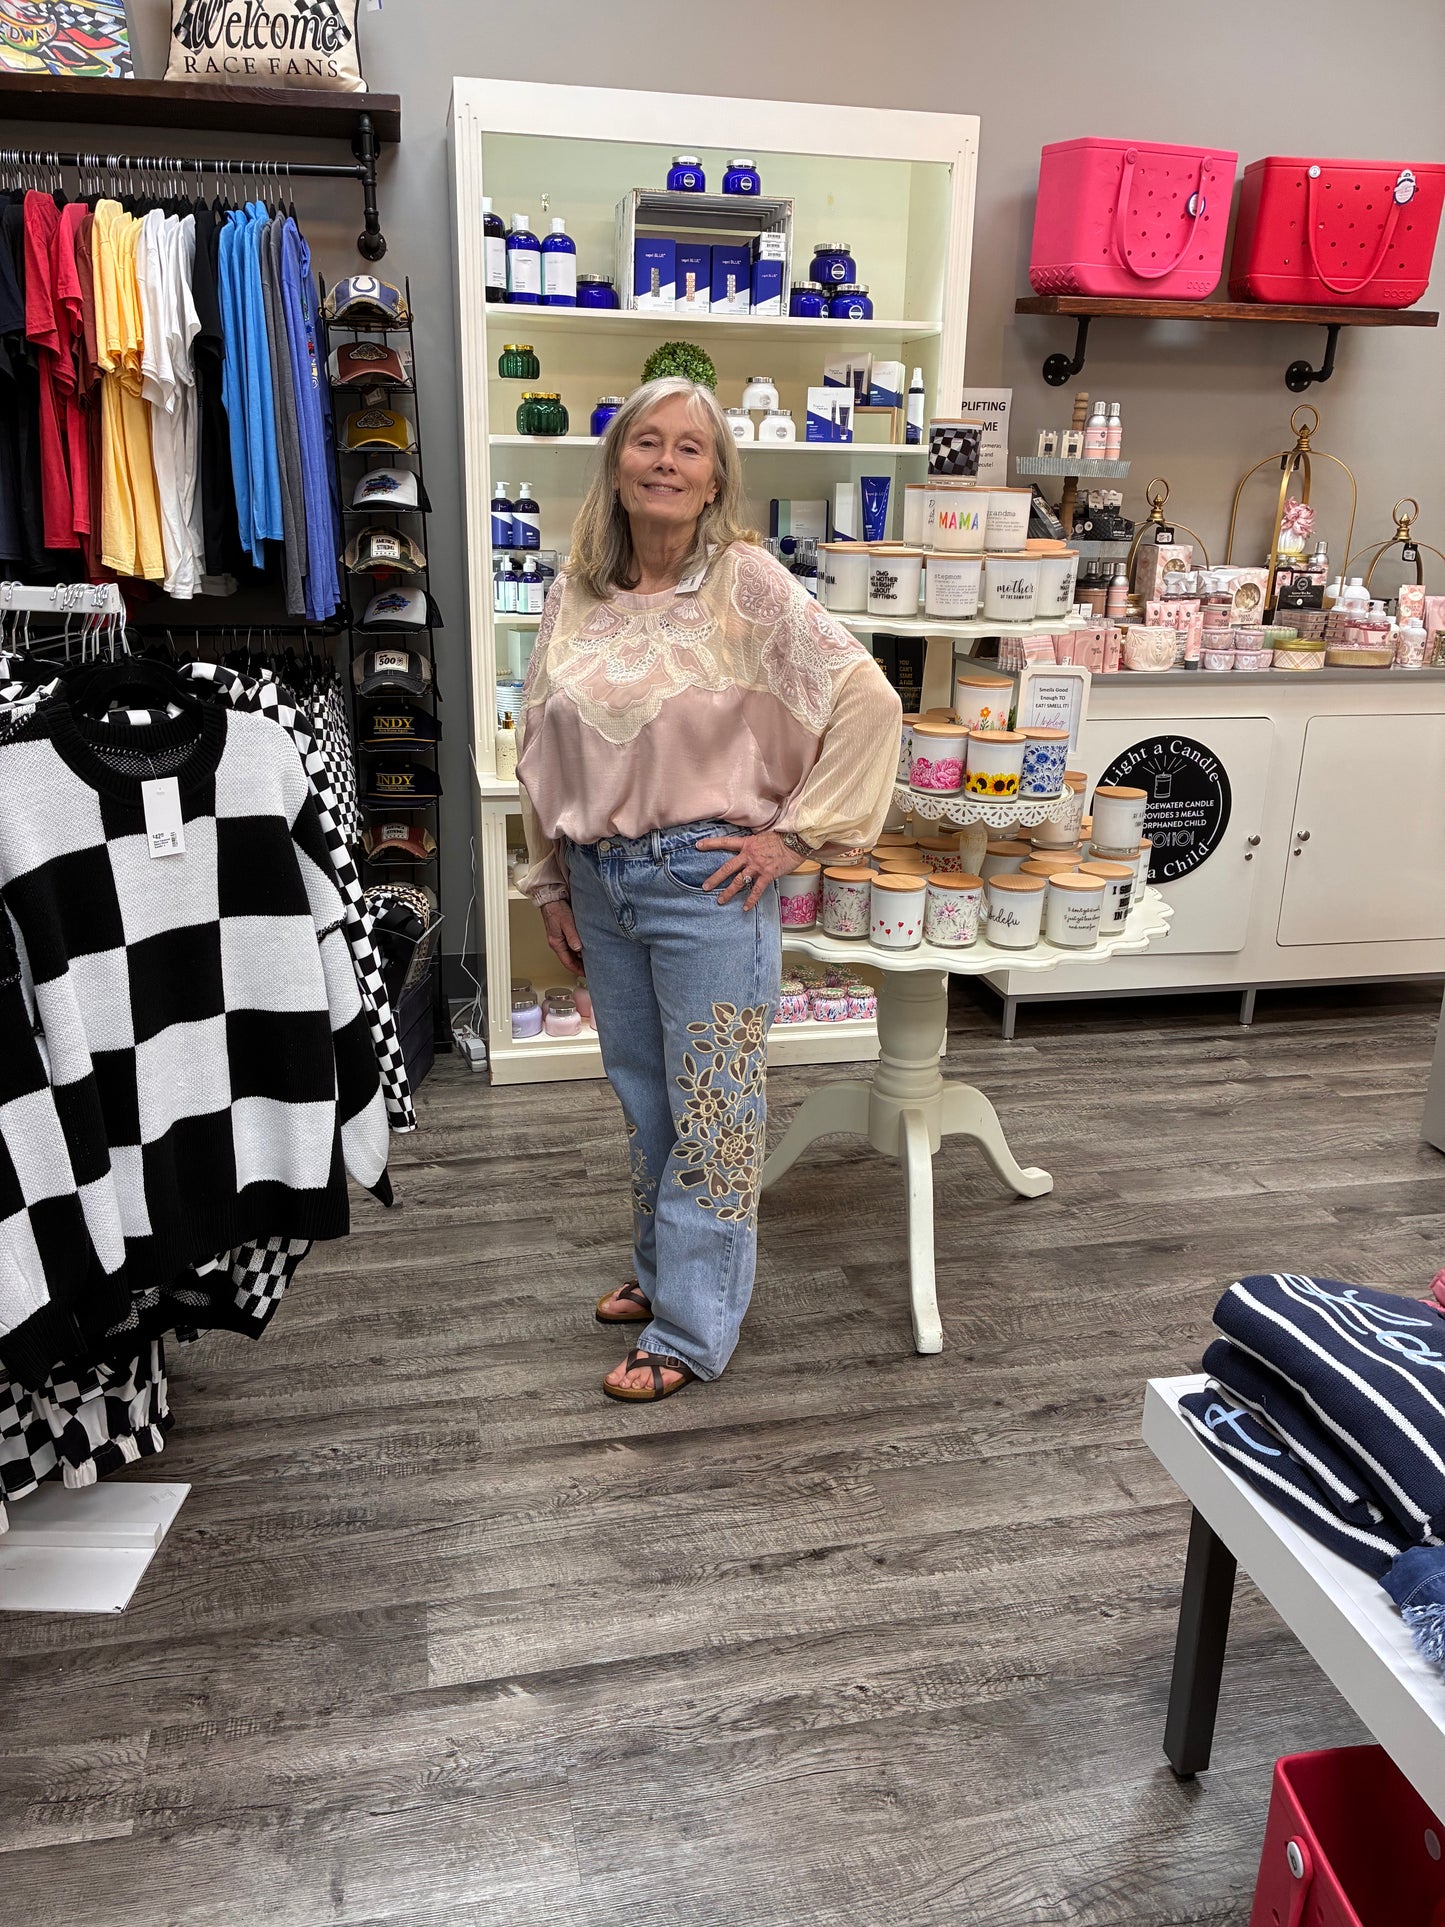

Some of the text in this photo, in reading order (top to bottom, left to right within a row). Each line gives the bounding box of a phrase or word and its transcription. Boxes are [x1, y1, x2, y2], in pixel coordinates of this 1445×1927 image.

[191, 0, 338, 52] Welcome
[183, 56, 338, 78] RACE FANS
[1187, 279, 1211, 292] bogg
[1384, 288, 1413, 300] bogg
[961, 401, 1006, 411] PLIFTING
[982, 421, 998, 431] ME
[939, 511, 979, 530] MAMA
[996, 578, 1035, 594] mother
[379, 657, 396, 666] 500
[373, 718, 413, 728] INDY
[1104, 740, 1220, 786] Light a Candle
[376, 775, 414, 785] INDY
[1145, 800, 1214, 810] DGEWATER CANDLE
[1143, 811, 1174, 820] ROVIDES
[1174, 811, 1180, 819] 3
[1180, 809, 1204, 818] MEALS
[1142, 820, 1183, 830] ORPHANED
[1184, 819, 1207, 827] CHILD
[1147, 842, 1210, 879] a Child
[988, 904, 1020, 928] bcdefu
